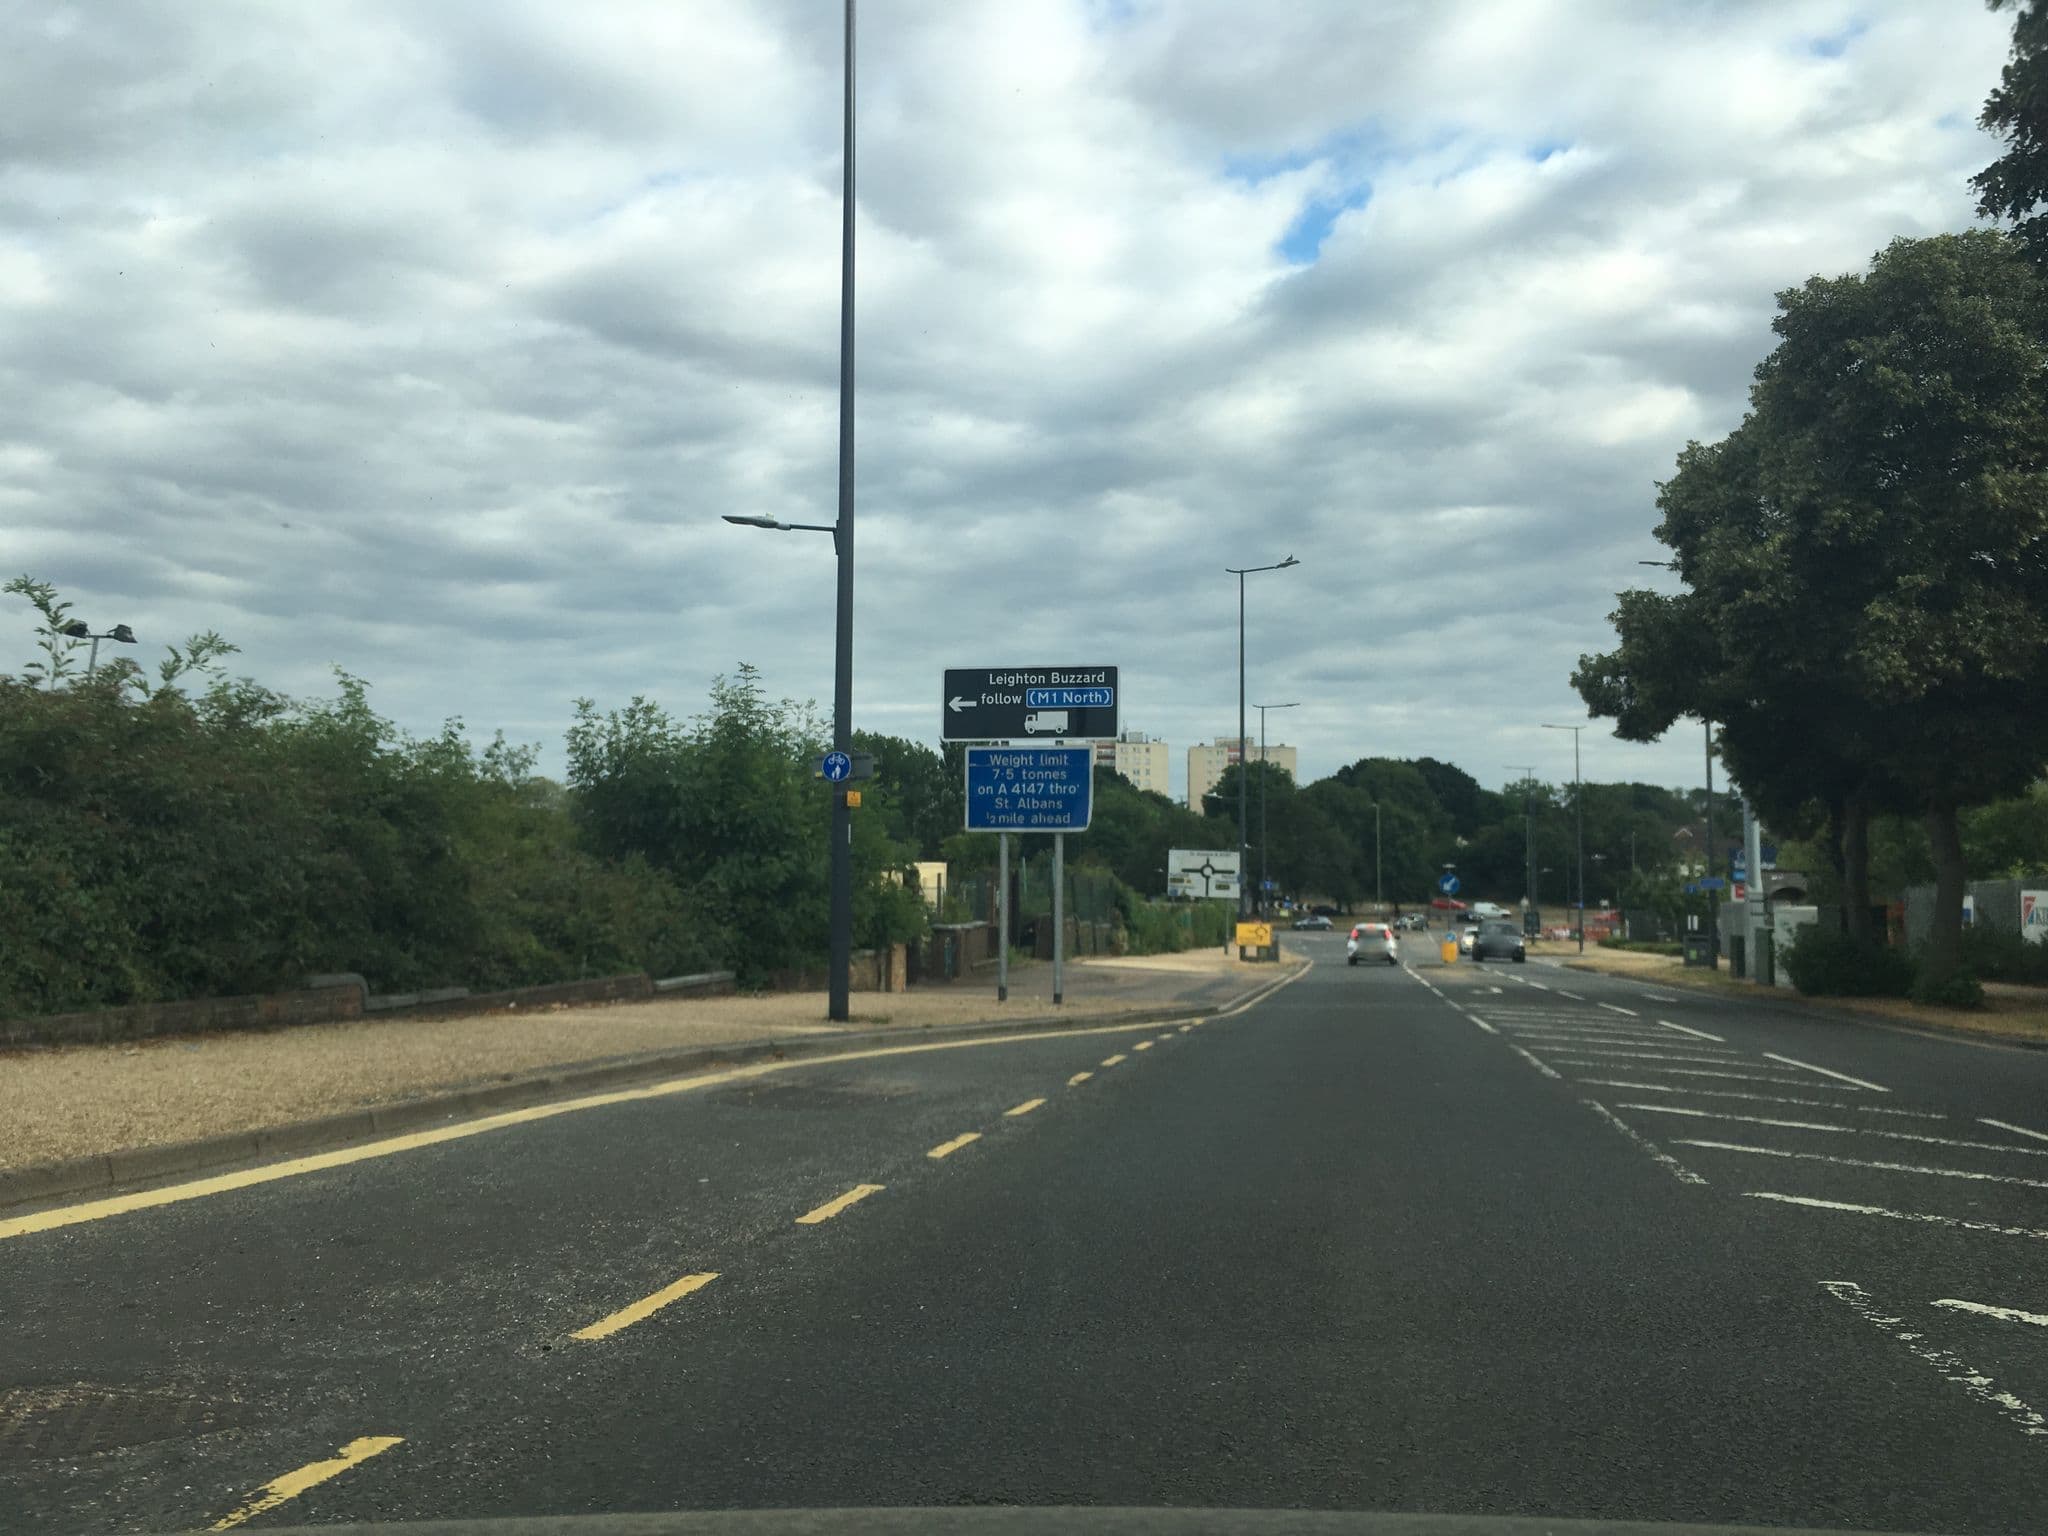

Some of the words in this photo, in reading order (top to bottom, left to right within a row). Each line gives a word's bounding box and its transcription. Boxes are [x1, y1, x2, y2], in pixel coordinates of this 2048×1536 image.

[989, 673, 1045, 686] Leighton
[1051, 672, 1104, 683] Buzzard
[981, 693, 1021, 704] follow
[990, 755, 1033, 767] Weight
[1041, 755, 1068, 765] limit
[1022, 769, 1067, 778] tonnes
[978, 786, 993, 794] on
[1012, 784, 1044, 793] 4147
[1018, 798, 1062, 809] Albans
[999, 813, 1025, 823] mile
[1031, 812, 1070, 823] ahead
